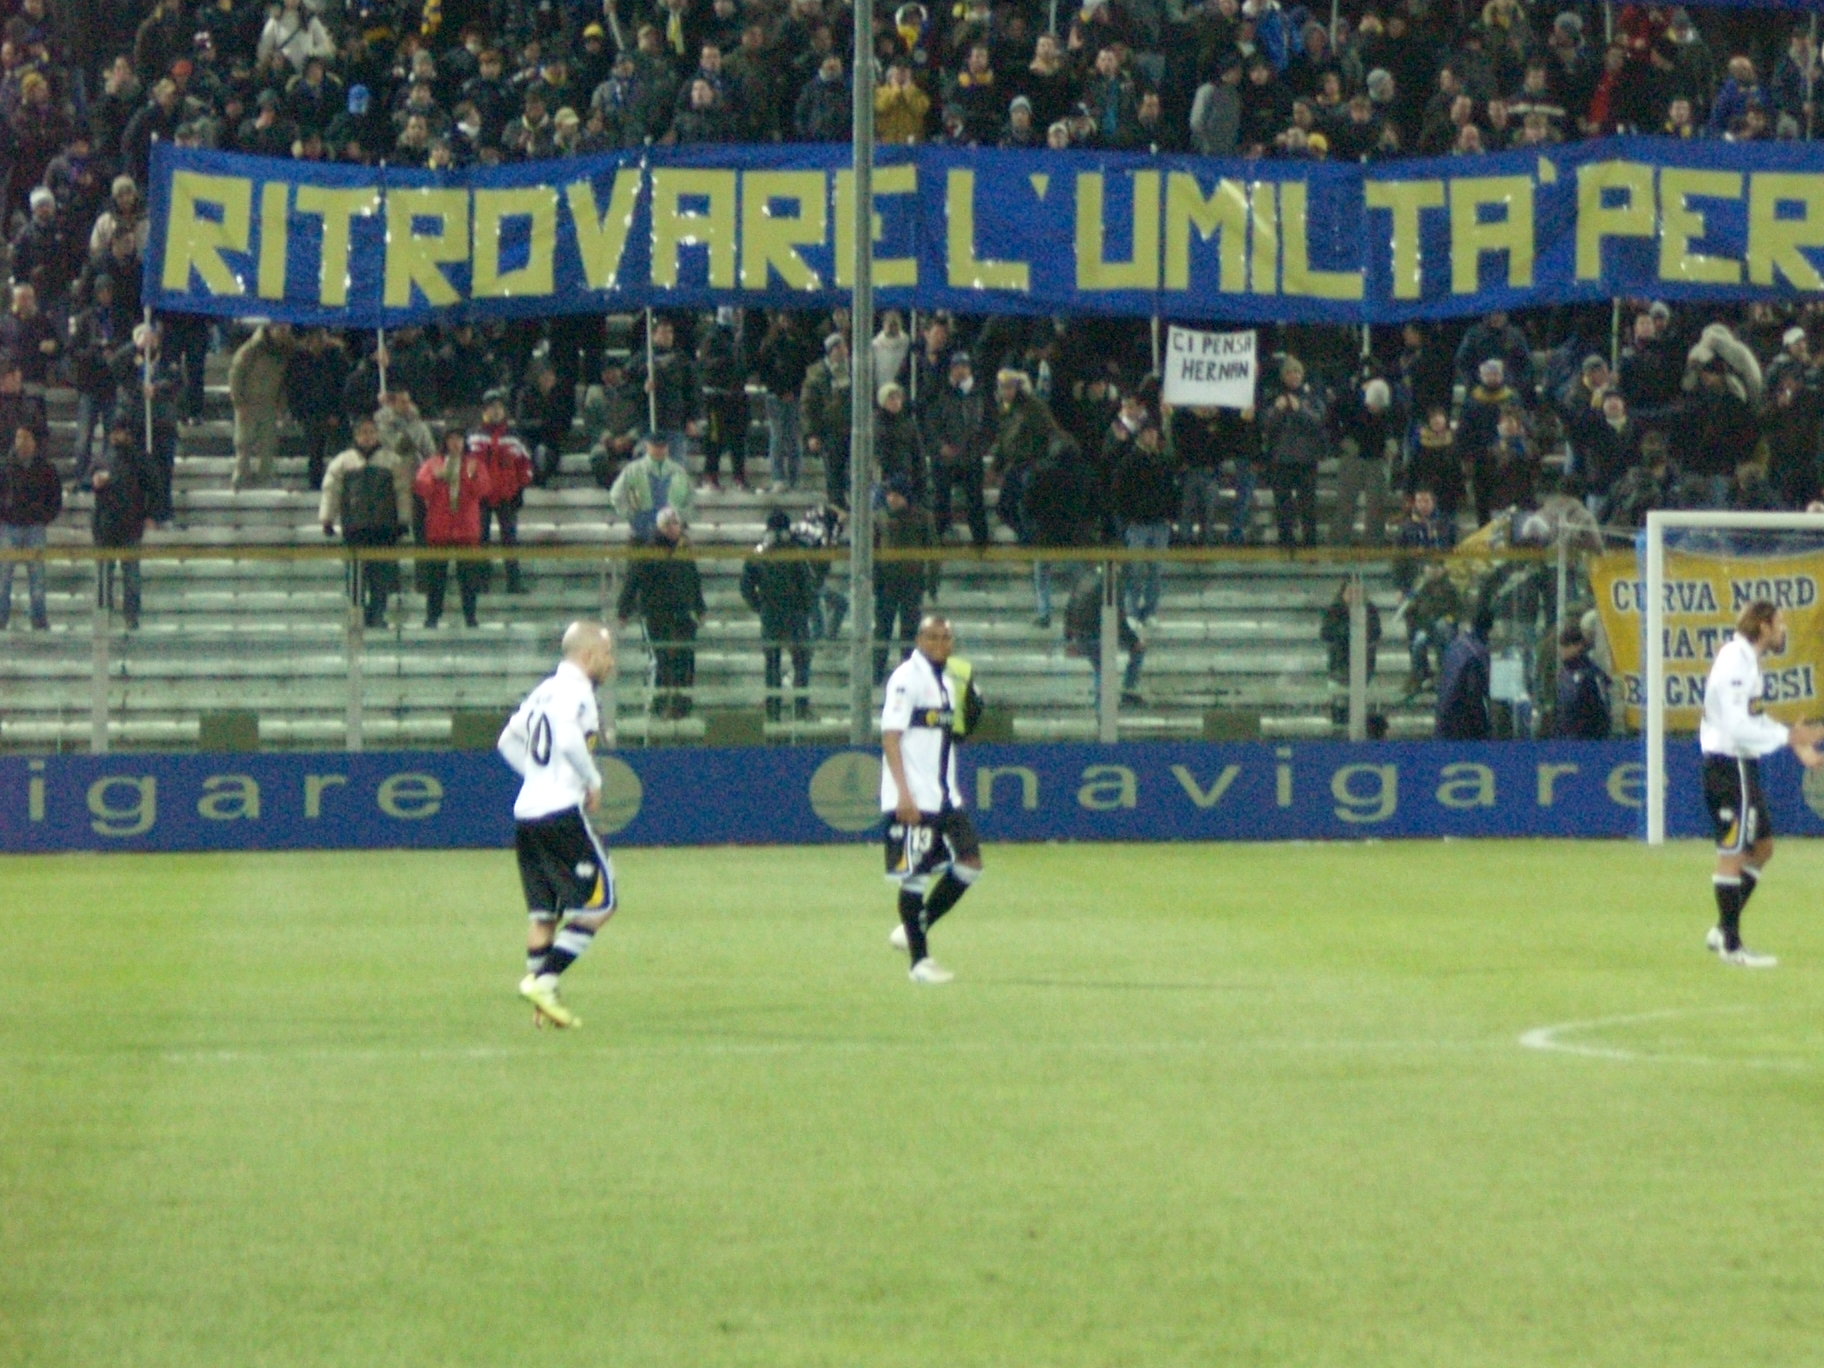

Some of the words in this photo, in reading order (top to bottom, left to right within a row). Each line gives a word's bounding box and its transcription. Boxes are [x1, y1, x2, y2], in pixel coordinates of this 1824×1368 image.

[160, 164, 918, 307] RITROVARE
[1172, 332, 1194, 352] CI
[1202, 334, 1252, 354] PENSA
[1181, 358, 1250, 381] HERNAN
[977, 747, 1670, 824] navigare
